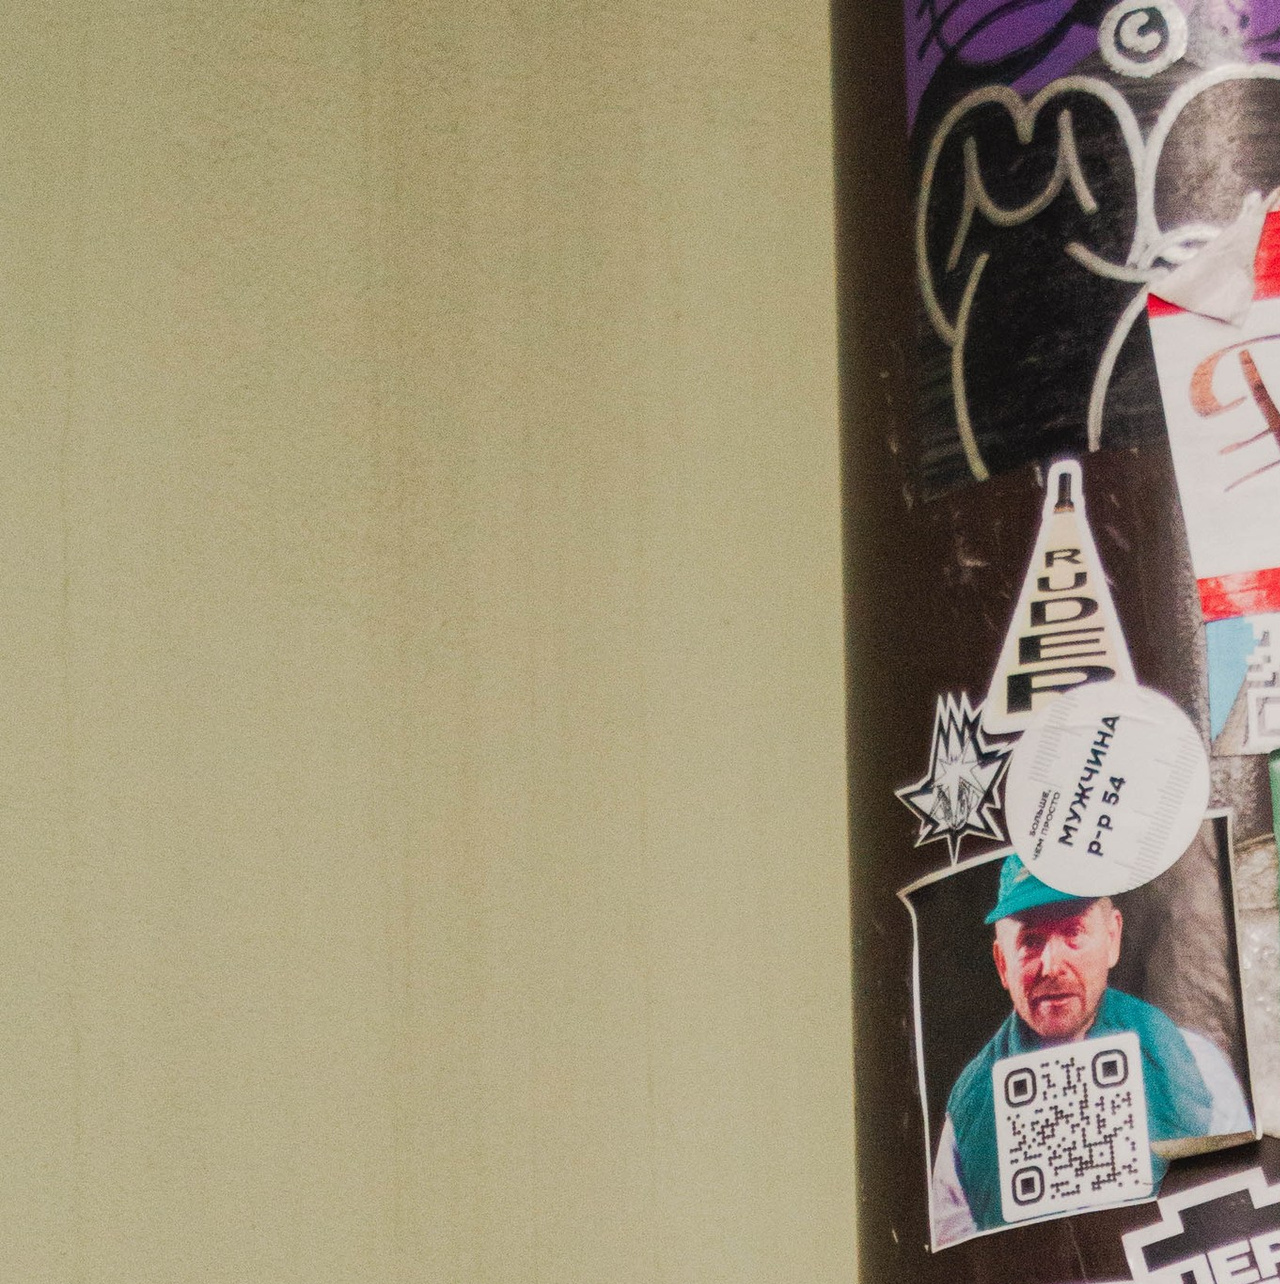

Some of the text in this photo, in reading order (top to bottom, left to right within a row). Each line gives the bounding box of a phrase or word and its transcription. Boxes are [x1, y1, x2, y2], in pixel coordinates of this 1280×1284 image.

[1057, 715, 1121, 848] МУЖЧИНА
[1102, 775, 1127, 806] 54
[1041, 791, 1061, 836] ПРОСТО
